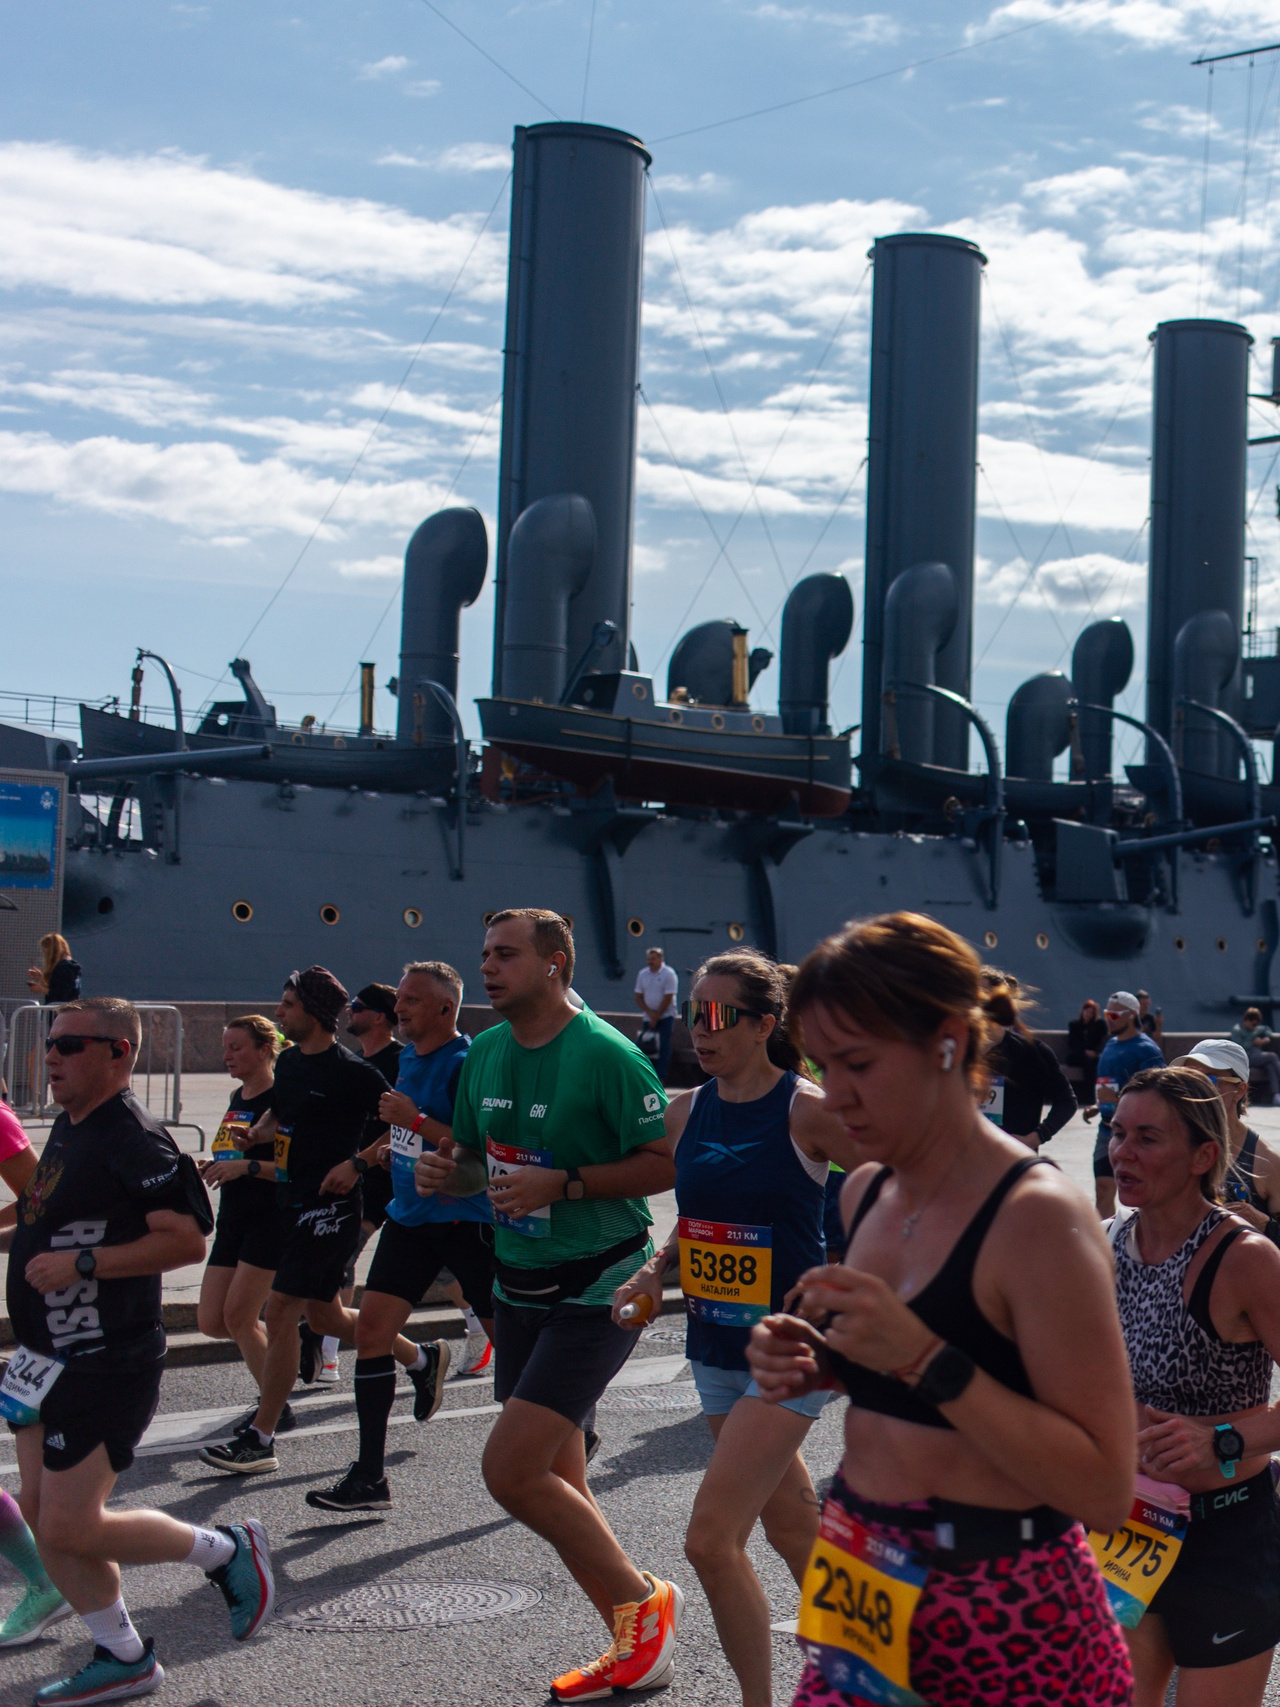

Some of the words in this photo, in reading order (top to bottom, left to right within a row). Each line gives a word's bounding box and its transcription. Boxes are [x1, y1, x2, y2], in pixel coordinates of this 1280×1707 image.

[638, 1112, 665, 1125] Пассво
[727, 1231, 742, 1240] 21,1
[690, 1247, 757, 1286] 5388
[44, 1219, 108, 1357] RSSI
[700, 1283, 740, 1297] НАТАЛИЯ
[1103, 1560, 1131, 1583] ИРИНА
[812, 1556, 893, 1646] 2348
